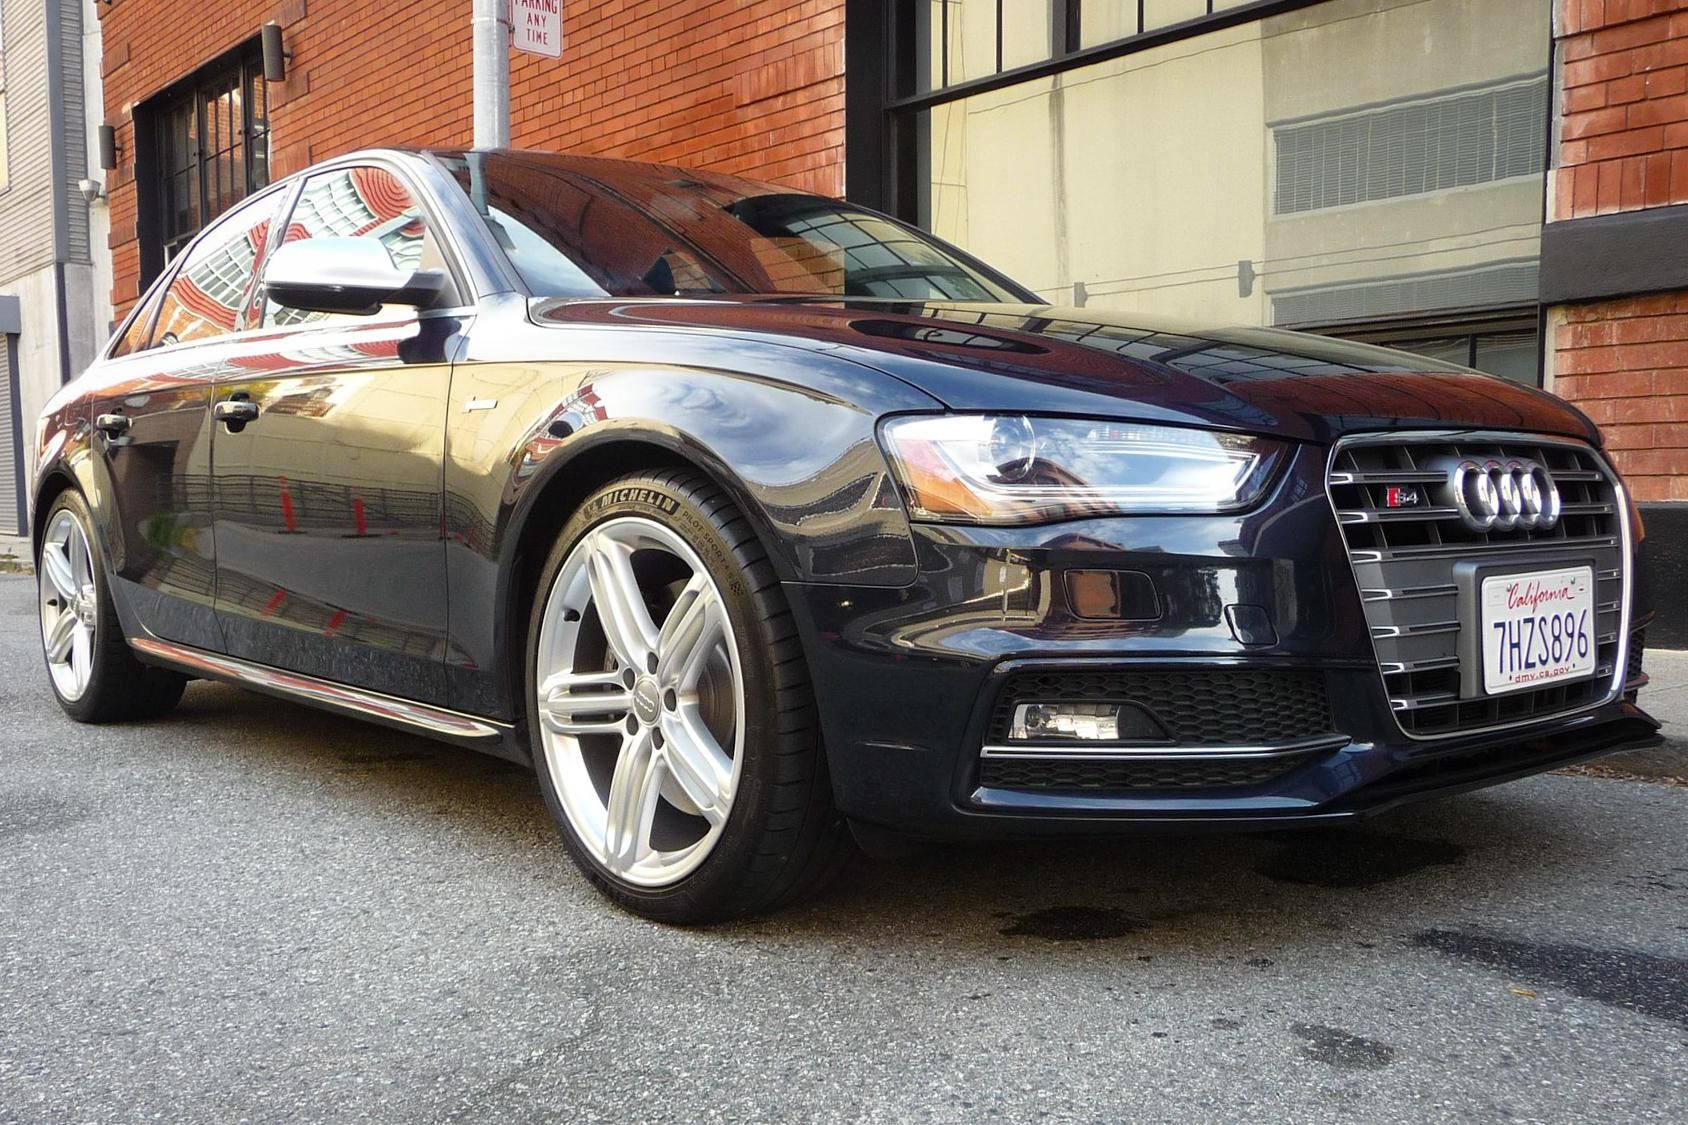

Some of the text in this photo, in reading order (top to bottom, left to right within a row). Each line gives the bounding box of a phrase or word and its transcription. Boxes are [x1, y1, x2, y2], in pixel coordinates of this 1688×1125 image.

[527, 12, 547, 28] ANY
[527, 28, 549, 45] TIME
[600, 488, 675, 514] MICHELIN
[682, 510, 704, 532] PILOT
[703, 532, 726, 563] SPORT
[1508, 580, 1575, 614] California
[1493, 609, 1588, 675] 7HZS896
[1514, 665, 1570, 683] dmv.ca.gov
